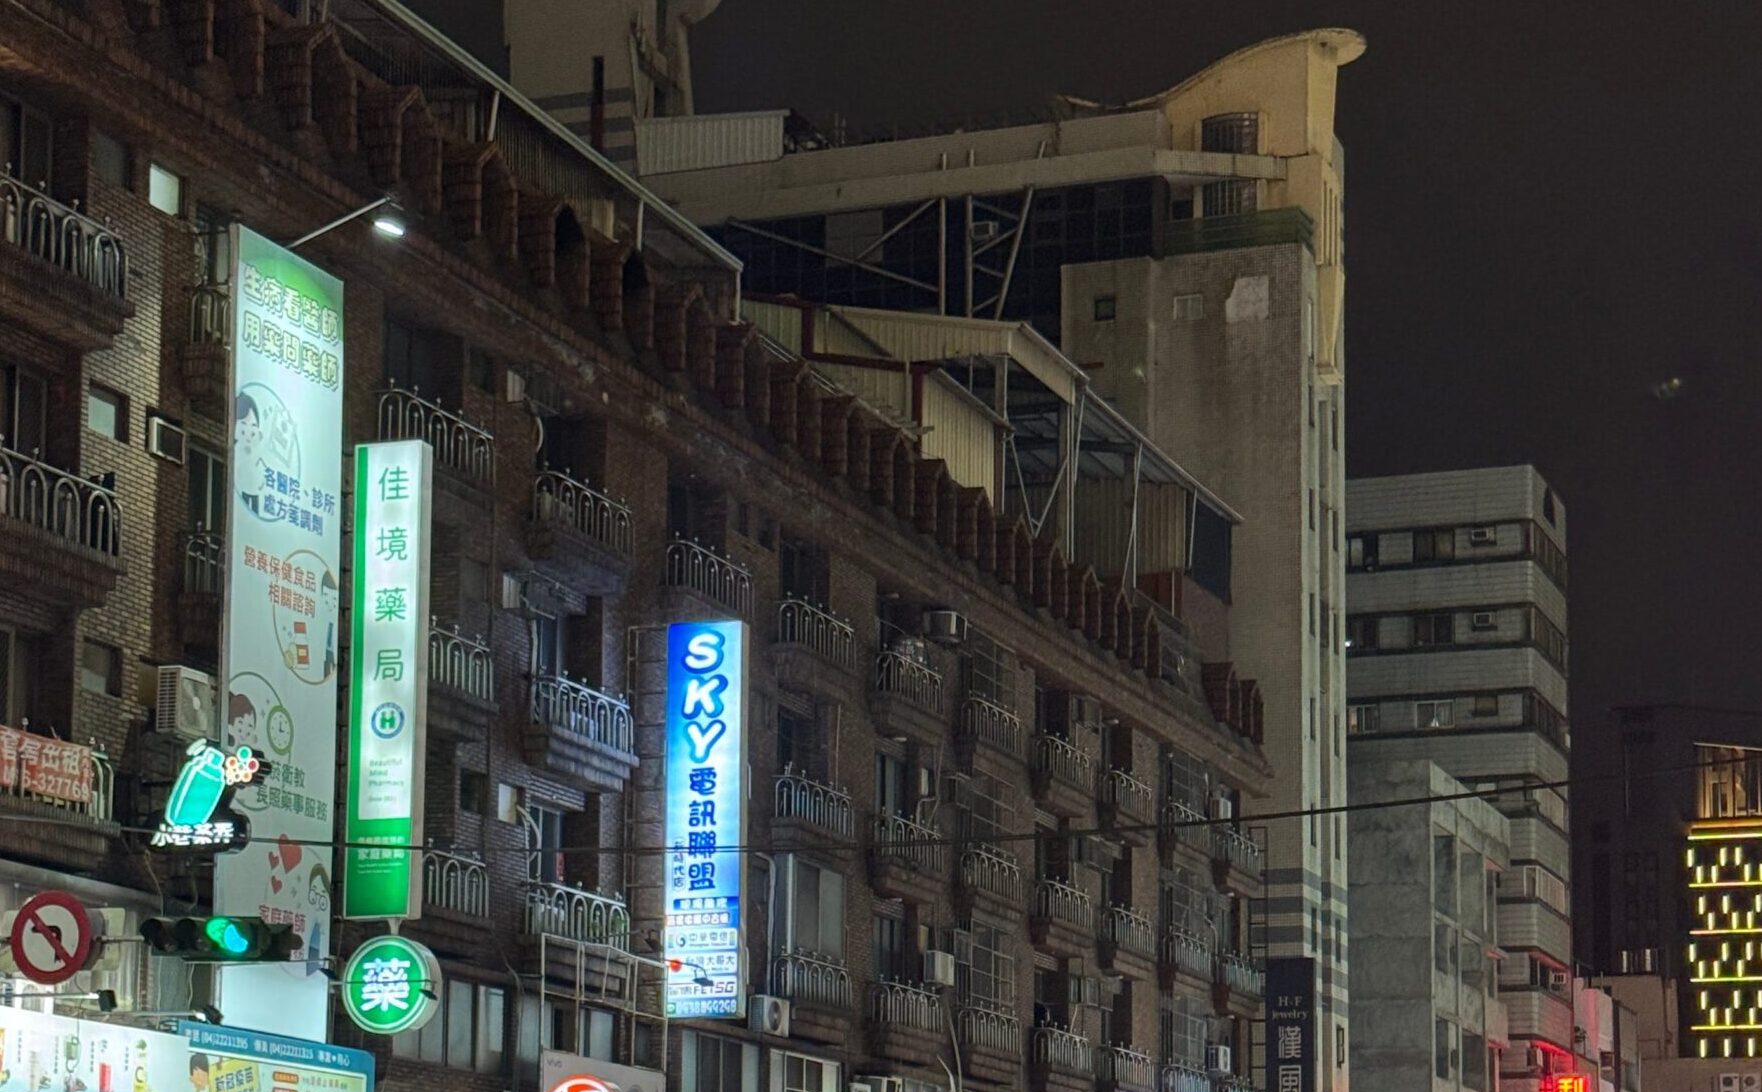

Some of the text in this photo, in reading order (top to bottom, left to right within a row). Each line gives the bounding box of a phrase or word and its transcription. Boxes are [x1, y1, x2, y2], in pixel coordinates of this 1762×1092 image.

[243, 311, 339, 391] 用藥問藥師
[264, 467, 336, 516] 各醫院、診所
[244, 545, 316, 592] 營養保健食品
[373, 466, 410, 682] 佳境藥局
[683, 631, 727, 763] SKY
[689, 767, 717, 891] 電訊聯盟
